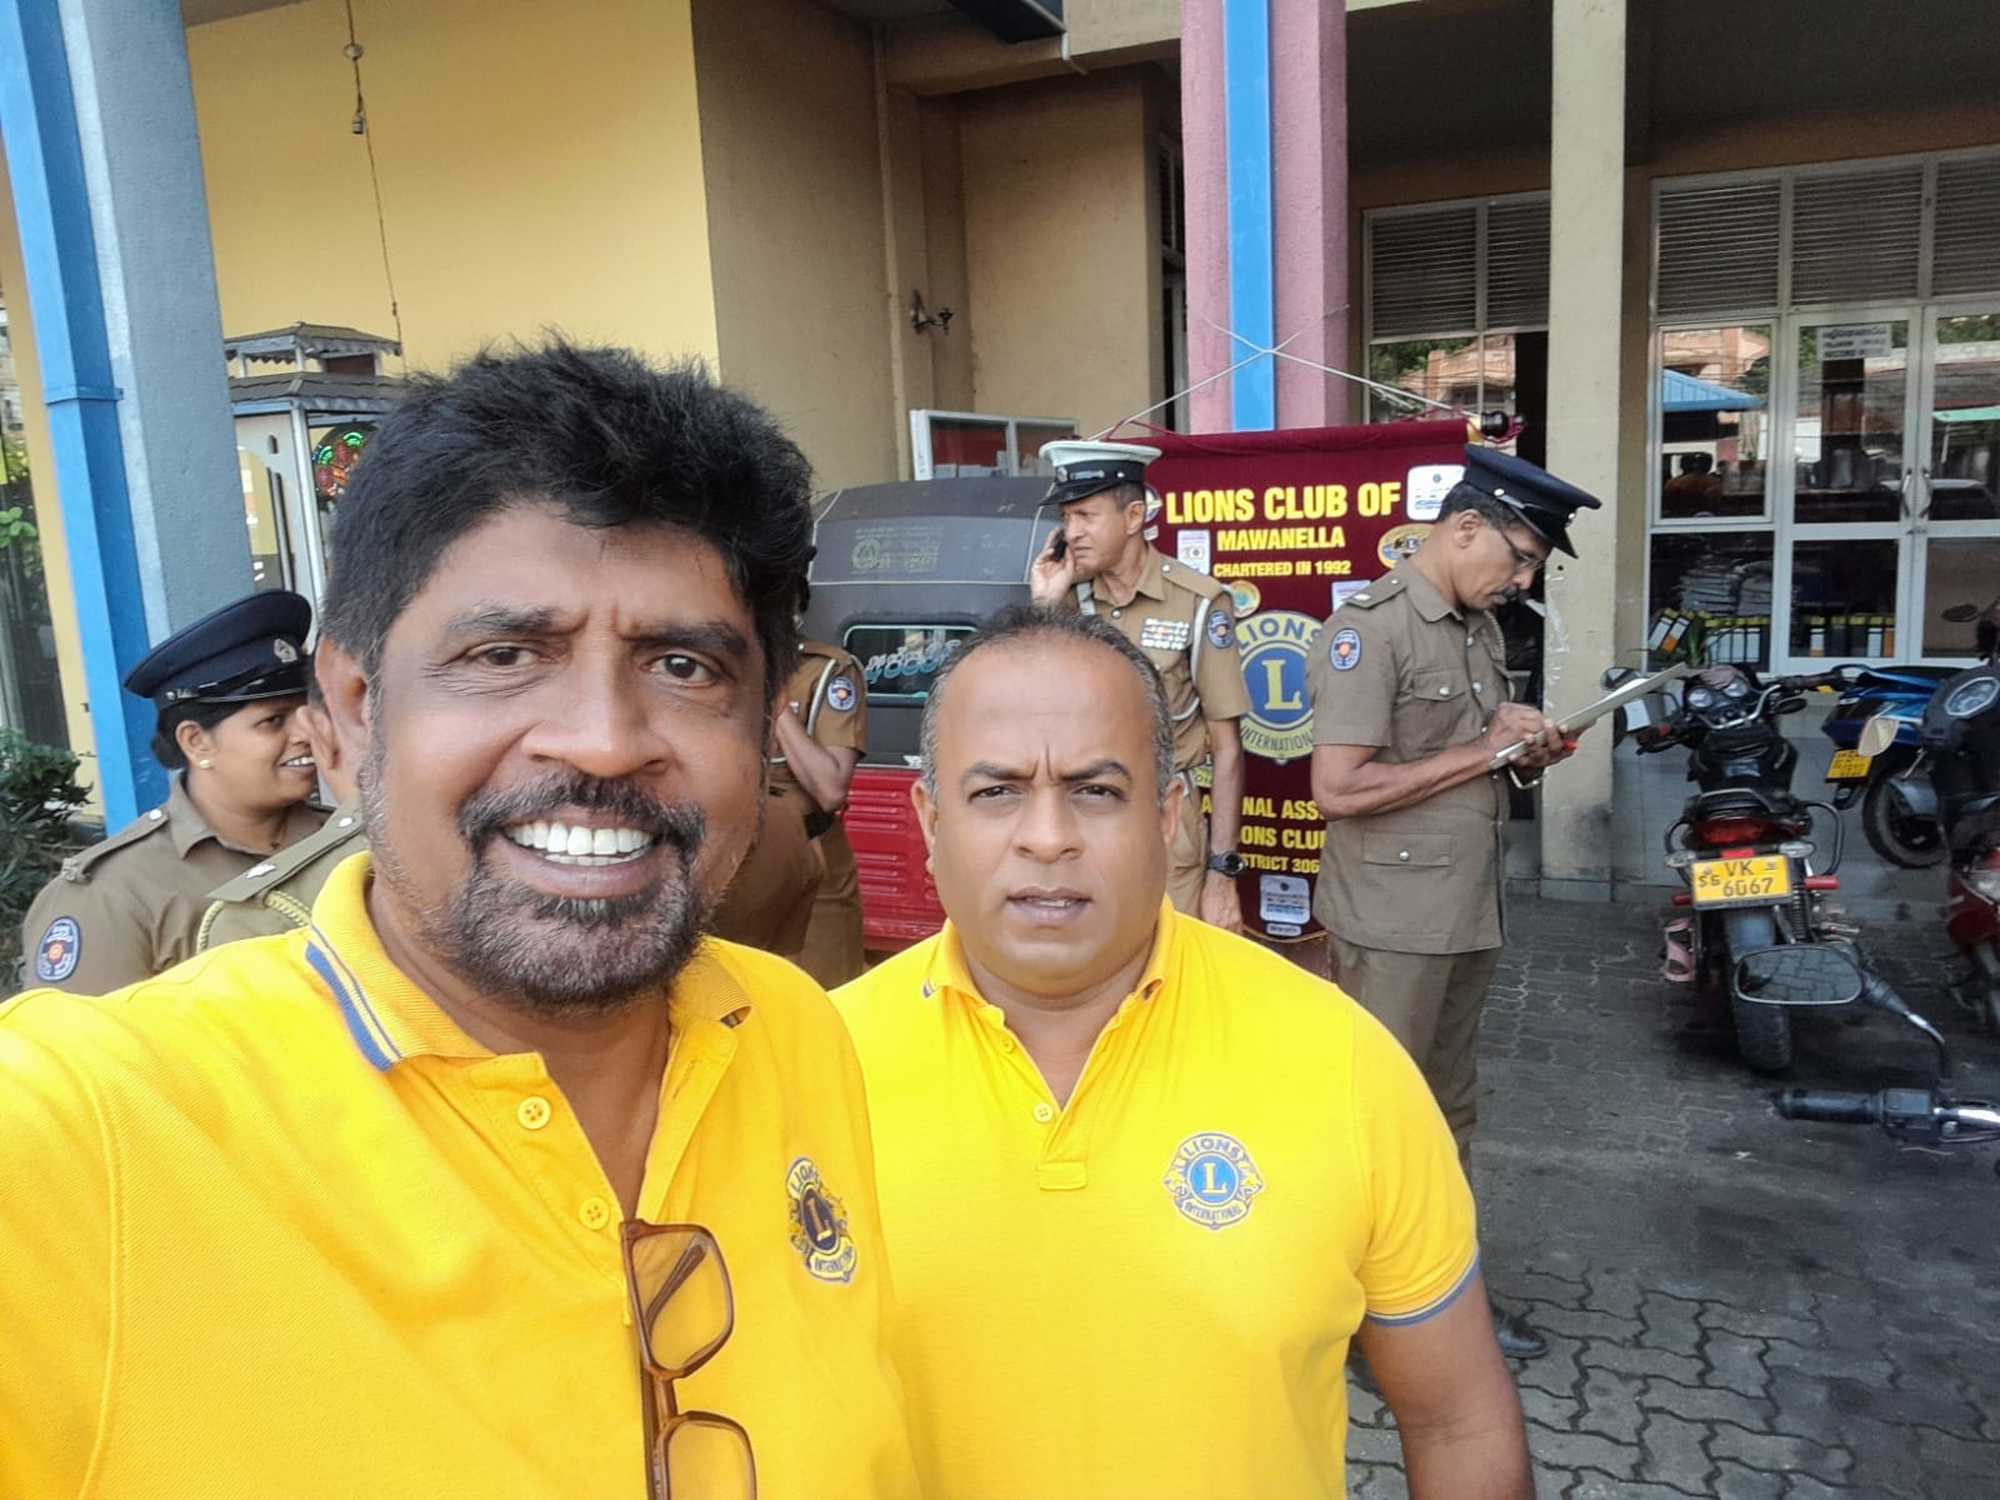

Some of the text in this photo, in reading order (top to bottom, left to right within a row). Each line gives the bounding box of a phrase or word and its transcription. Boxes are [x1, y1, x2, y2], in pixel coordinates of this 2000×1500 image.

[1166, 488, 1255, 524] LIONS
[1264, 484, 1348, 521] CLUB
[1357, 481, 1401, 517] OF
[1217, 526, 1345, 551] MAWANELLA
[1213, 560, 1351, 577] CHARTERED IN 1992
[1261, 659, 1303, 711] L
[1723, 859, 1754, 877] VK
[1723, 877, 1774, 898] 6067
[1183, 1138, 1241, 1160] LIONS
[1202, 1162, 1228, 1195] L
